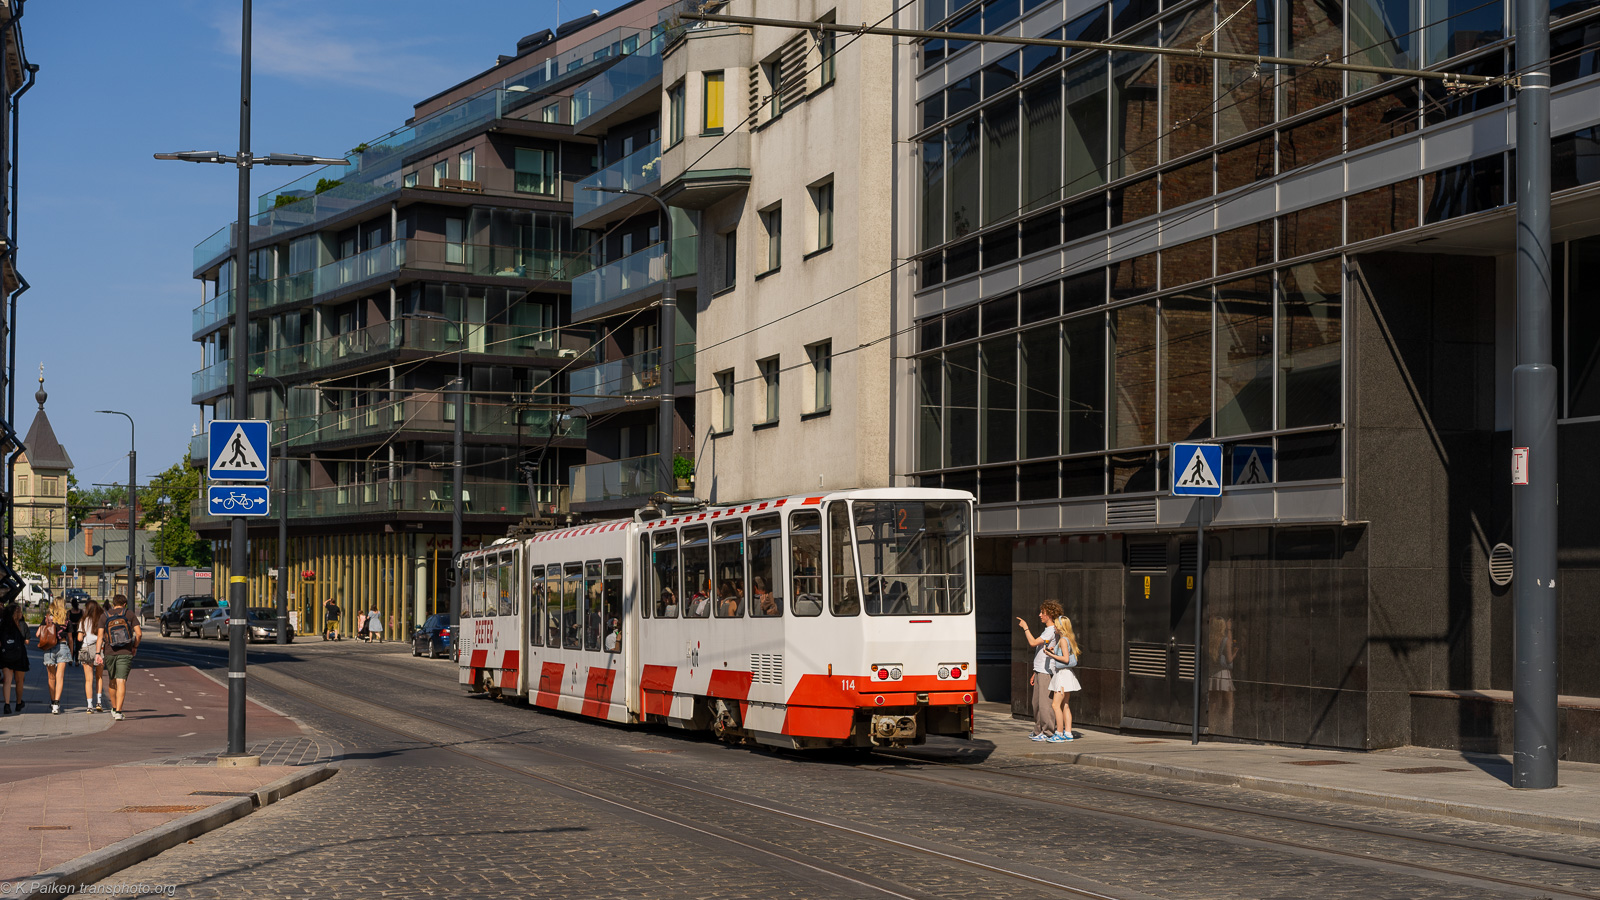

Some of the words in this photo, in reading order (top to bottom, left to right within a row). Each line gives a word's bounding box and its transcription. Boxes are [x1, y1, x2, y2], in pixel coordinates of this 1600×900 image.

[898, 508, 908, 530] 2
[426, 536, 481, 549] VAPINO
[475, 619, 494, 644] PEETER
[841, 679, 856, 691] 114
